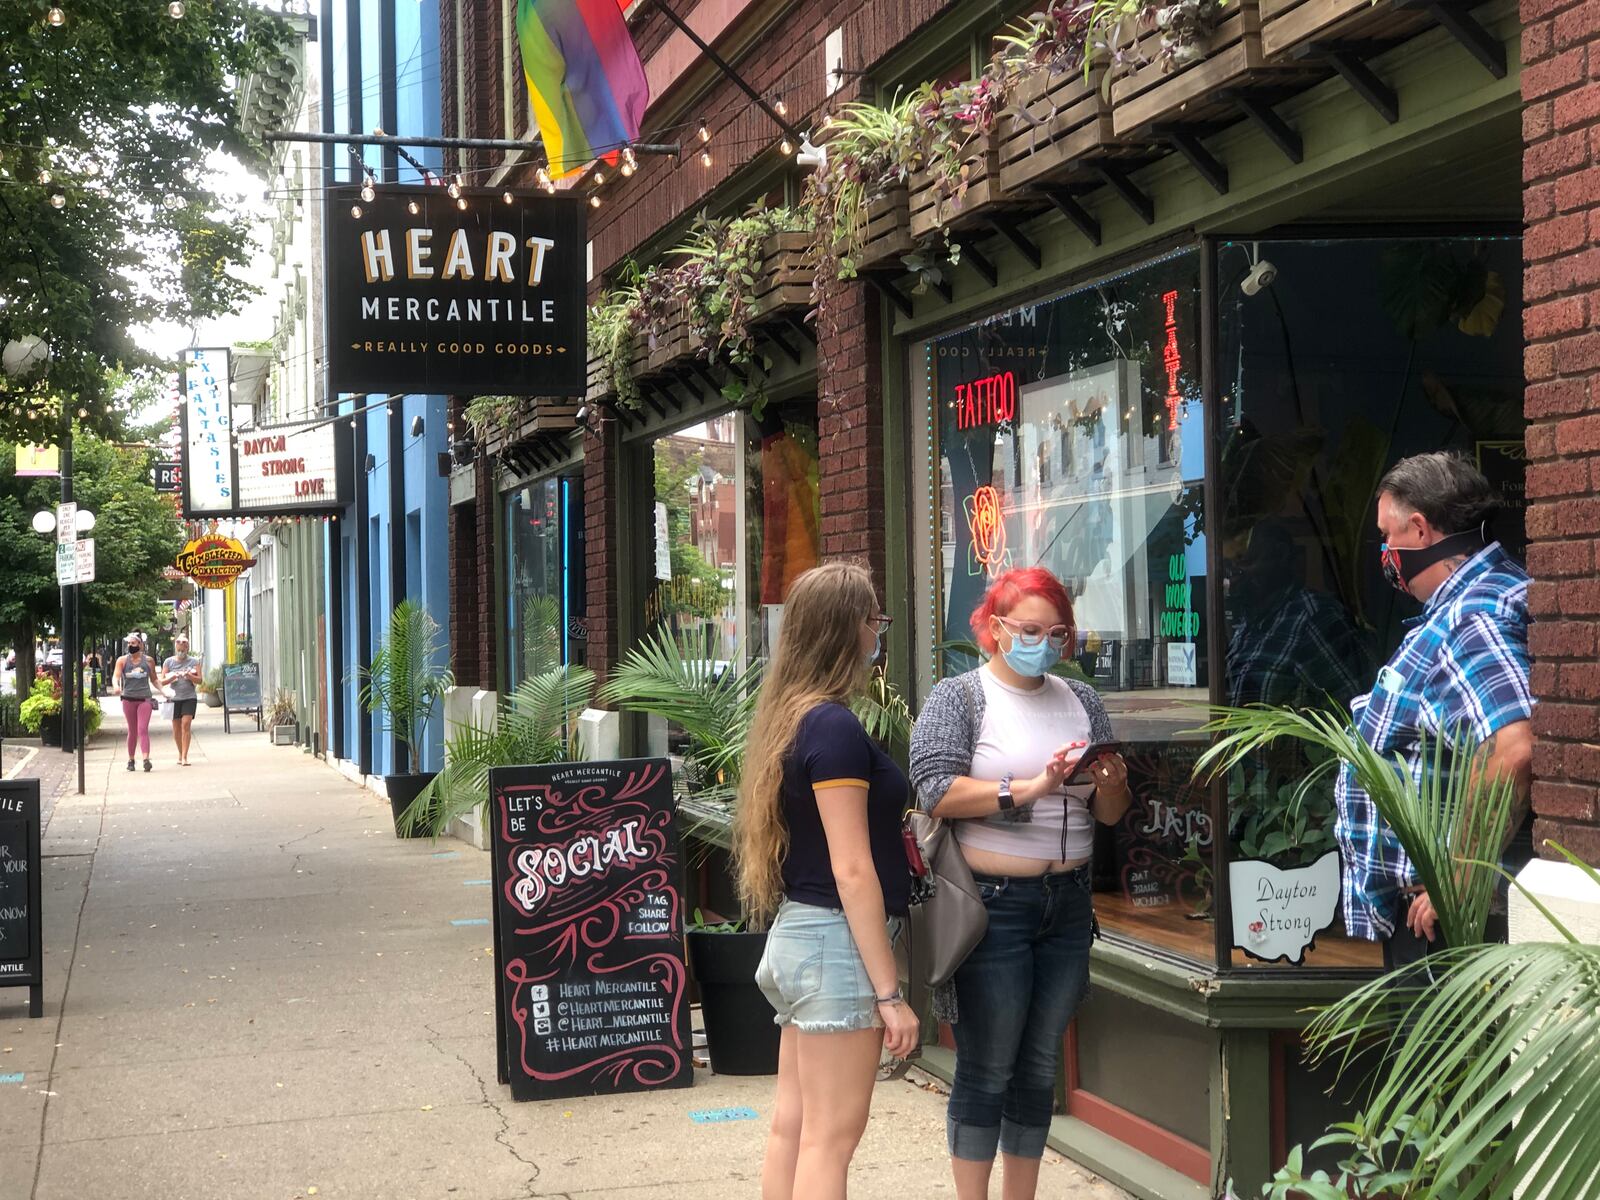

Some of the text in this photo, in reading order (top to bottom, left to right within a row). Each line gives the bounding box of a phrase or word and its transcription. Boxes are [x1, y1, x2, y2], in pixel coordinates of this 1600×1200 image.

[361, 228, 554, 287] HEART
[361, 297, 554, 322] MERCANTILE
[364, 341, 553, 355] REALLY GOOD GOODS
[955, 371, 1015, 430] TATTOO
[188, 380, 231, 498] FANTASIES
[243, 435, 286, 457] DAYTON
[161, 470, 182, 484] RE
[261, 457, 305, 477] STRONG
[294, 478, 325, 497] LOVE
[177, 549, 243, 573] TUMBLEWEED
[1169, 553, 1185, 581] OLD
[1165, 583, 1192, 609] WORK
[1160, 611, 1200, 637] COVERED
[551, 769, 574, 782] HEART
[576, 768, 622, 778] MERCANTILE
[0, 797, 24, 812] ILE
[508, 794, 543, 812] LET'S
[511, 817, 526, 832] BE
[3, 859, 27, 873] YOUR
[515, 821, 648, 910] SOCIAL
[1256, 876, 1318, 910] Dayton
[628, 921, 670, 934] FOLLOW
[1258, 907, 1311, 939] Strong
[0, 963, 24, 973] NTILE
[559, 980, 657, 998] HEART MERCANTILE
[557, 997, 664, 1016] @HEARTMERCANTILE
[557, 1012, 671, 1032] @HEART_MERCANTILE
